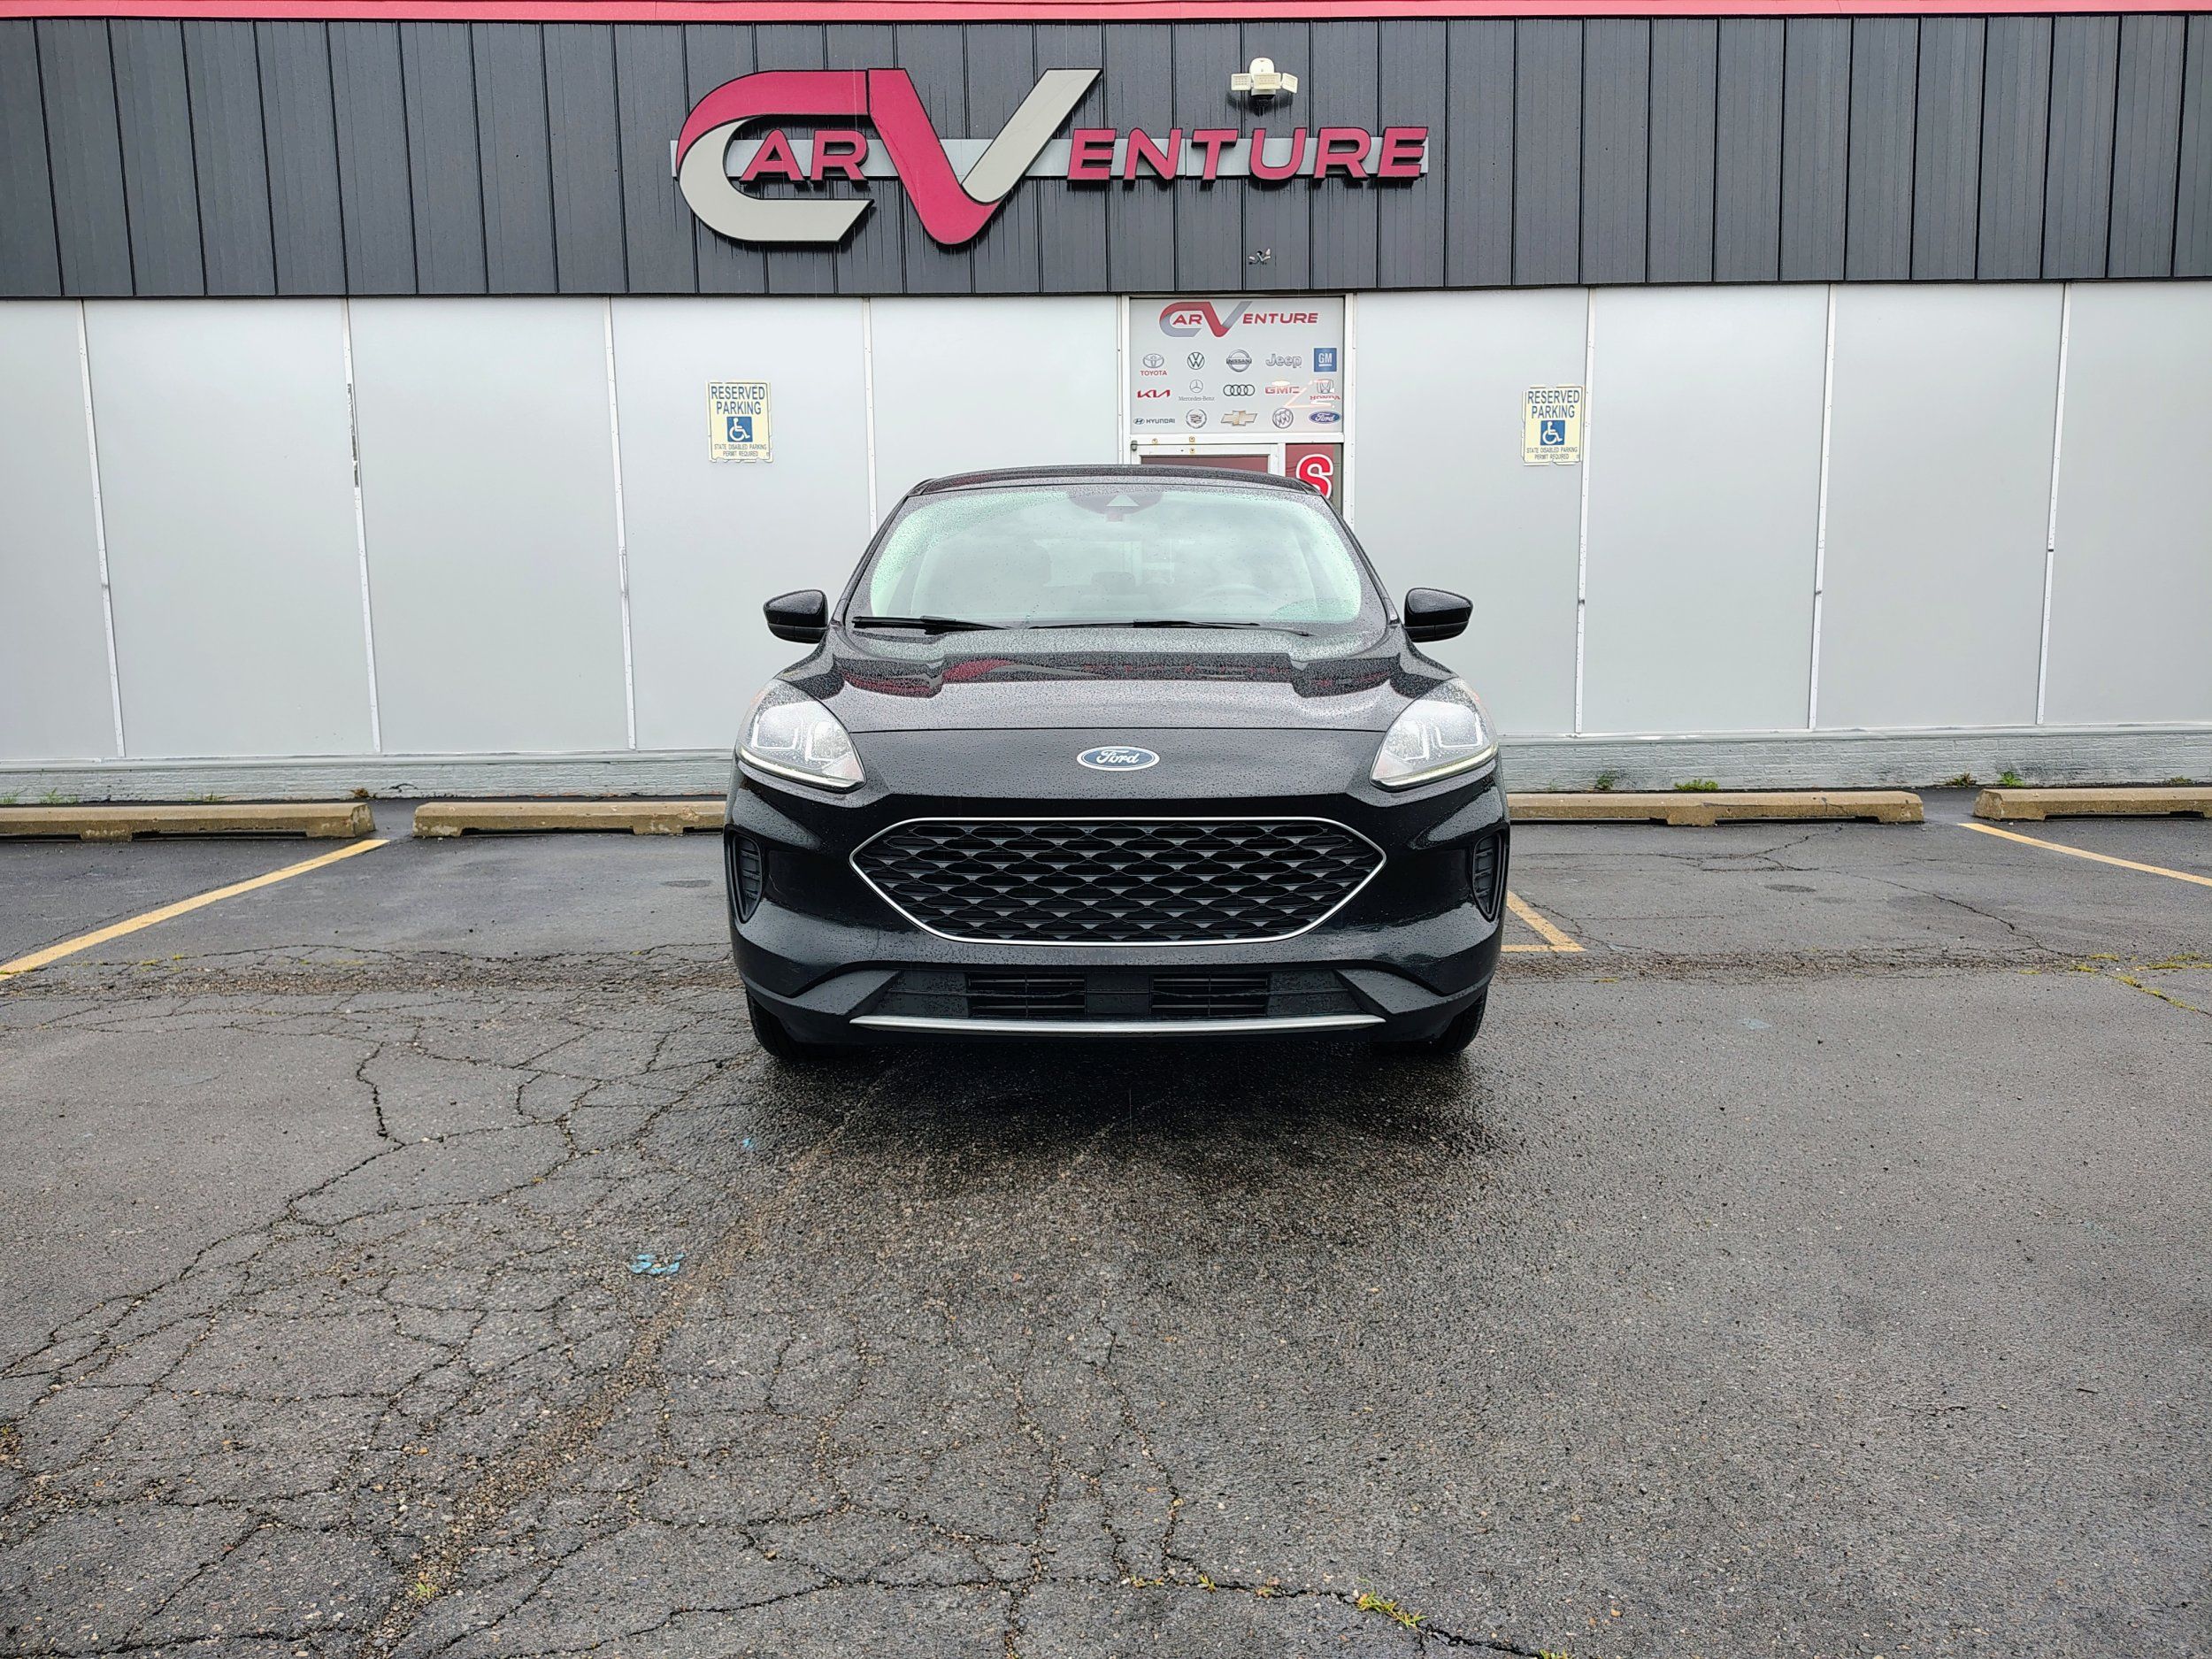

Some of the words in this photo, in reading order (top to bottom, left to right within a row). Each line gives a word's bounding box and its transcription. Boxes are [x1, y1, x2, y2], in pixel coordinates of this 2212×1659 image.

[1265, 354, 1302, 368] Jeep
[1318, 353, 1333, 364] GM
[710, 386, 765, 400] RESERVED
[1527, 390, 1580, 404] RESERVED
[716, 401, 762, 415] PARKING
[1531, 404, 1575, 419] PARKING
[1315, 412, 1334, 422] Ford
[1296, 454, 1333, 500] S
[1095, 749, 1141, 764] Ford
